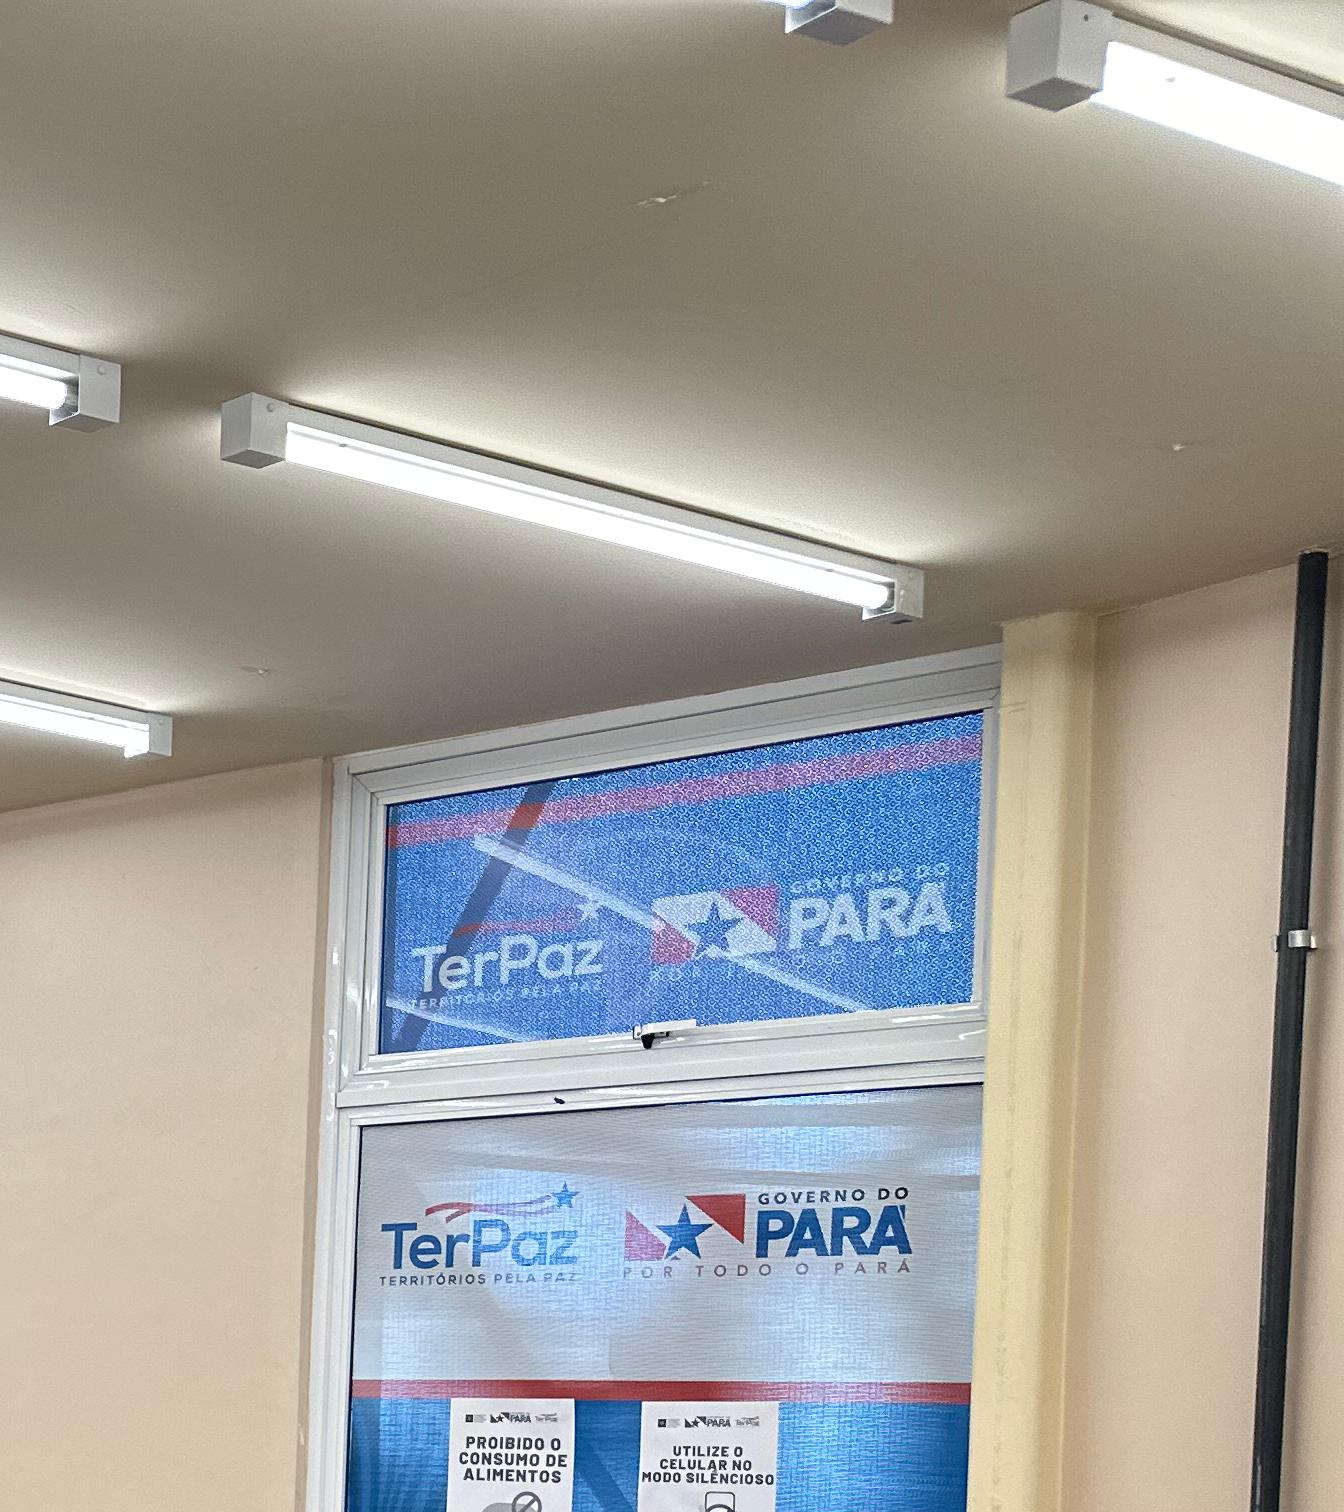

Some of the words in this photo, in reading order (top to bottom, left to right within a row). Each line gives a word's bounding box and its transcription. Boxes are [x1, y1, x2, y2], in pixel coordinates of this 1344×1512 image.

[412, 934, 604, 993] TerPaz
[758, 1189, 865, 1205] GOVERNO
[877, 1187, 909, 1200] DO
[755, 1204, 912, 1259] PARÁ
[381, 1218, 577, 1270] TerPaz
[623, 1266, 673, 1279] POR
[697, 1264, 772, 1278] TODO
[796, 1262, 809, 1275] O
[834, 1258, 911, 1274] PARÁ
[379, 1273, 486, 1286] TERRITÓRIOS
[494, 1273, 537, 1285] PELA
[544, 1272, 577, 1283] PAZ
[465, 1436, 545, 1452] PROIBIDO
[550, 1437, 562, 1452] O
[672, 1445, 729, 1458] UTILIZE
[733, 1446, 744, 1457] O
[458, 1452, 541, 1467] CONSUMO
[545, 1454, 568, 1468] DE
[659, 1458, 729, 1472] CELULAR
[732, 1460, 753, 1472] NO
[463, 1468, 562, 1484] ALIMENTOS
[641, 1471, 682, 1485] MODO
[686, 1472, 775, 1486] SILENCIOSO
